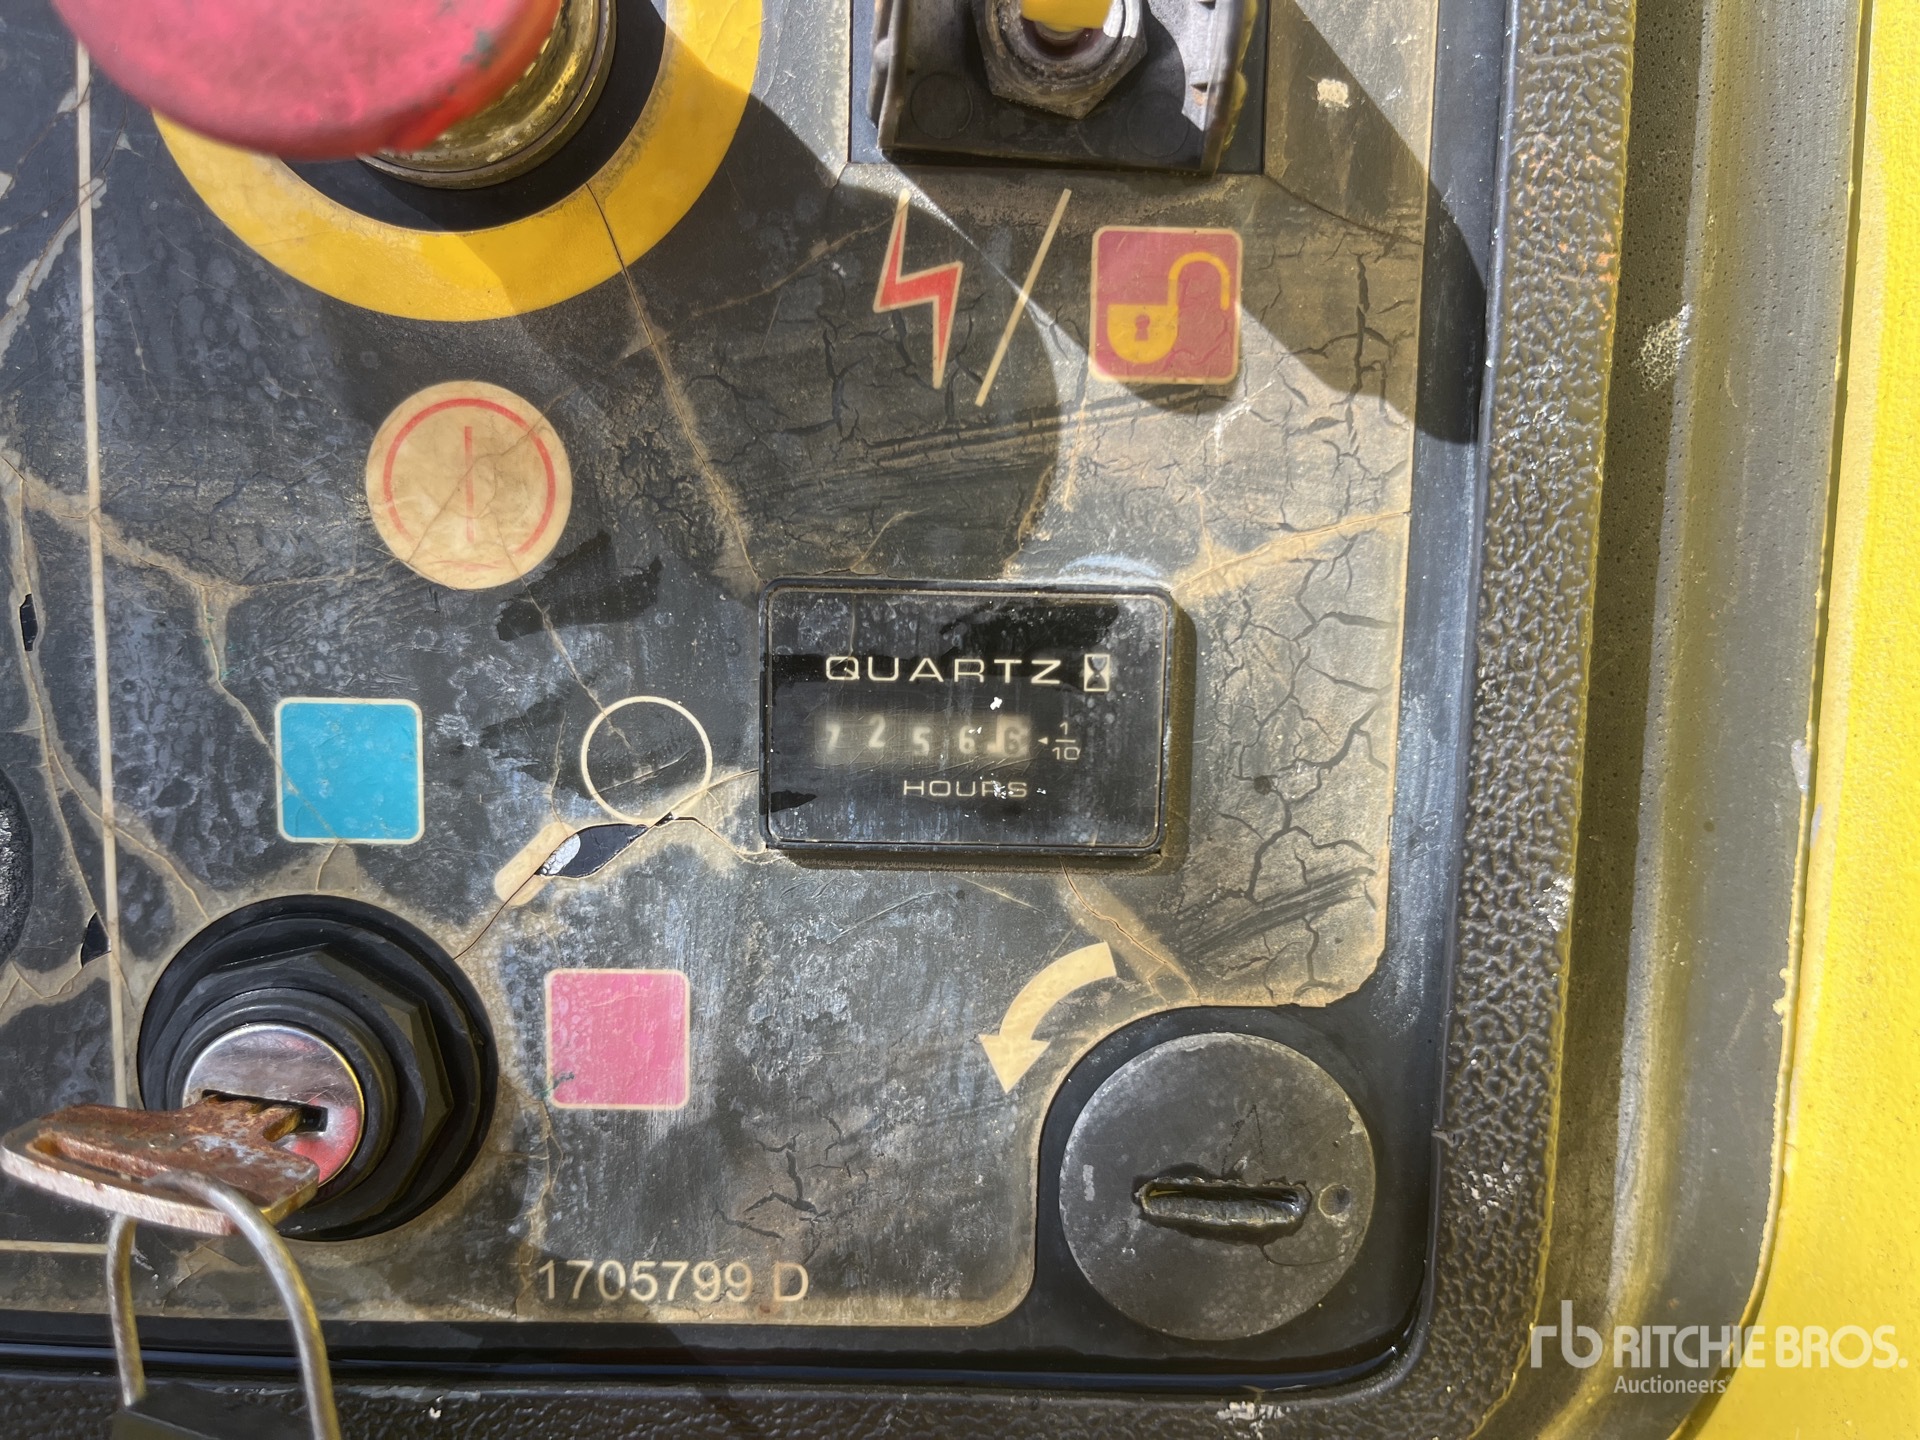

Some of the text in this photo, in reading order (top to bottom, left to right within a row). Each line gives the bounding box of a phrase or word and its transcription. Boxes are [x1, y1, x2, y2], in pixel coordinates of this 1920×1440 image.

[825, 656, 1061, 683] QUARTZ
[903, 780, 1028, 798] HOURS
[539, 1260, 809, 1301] 1705799 D
